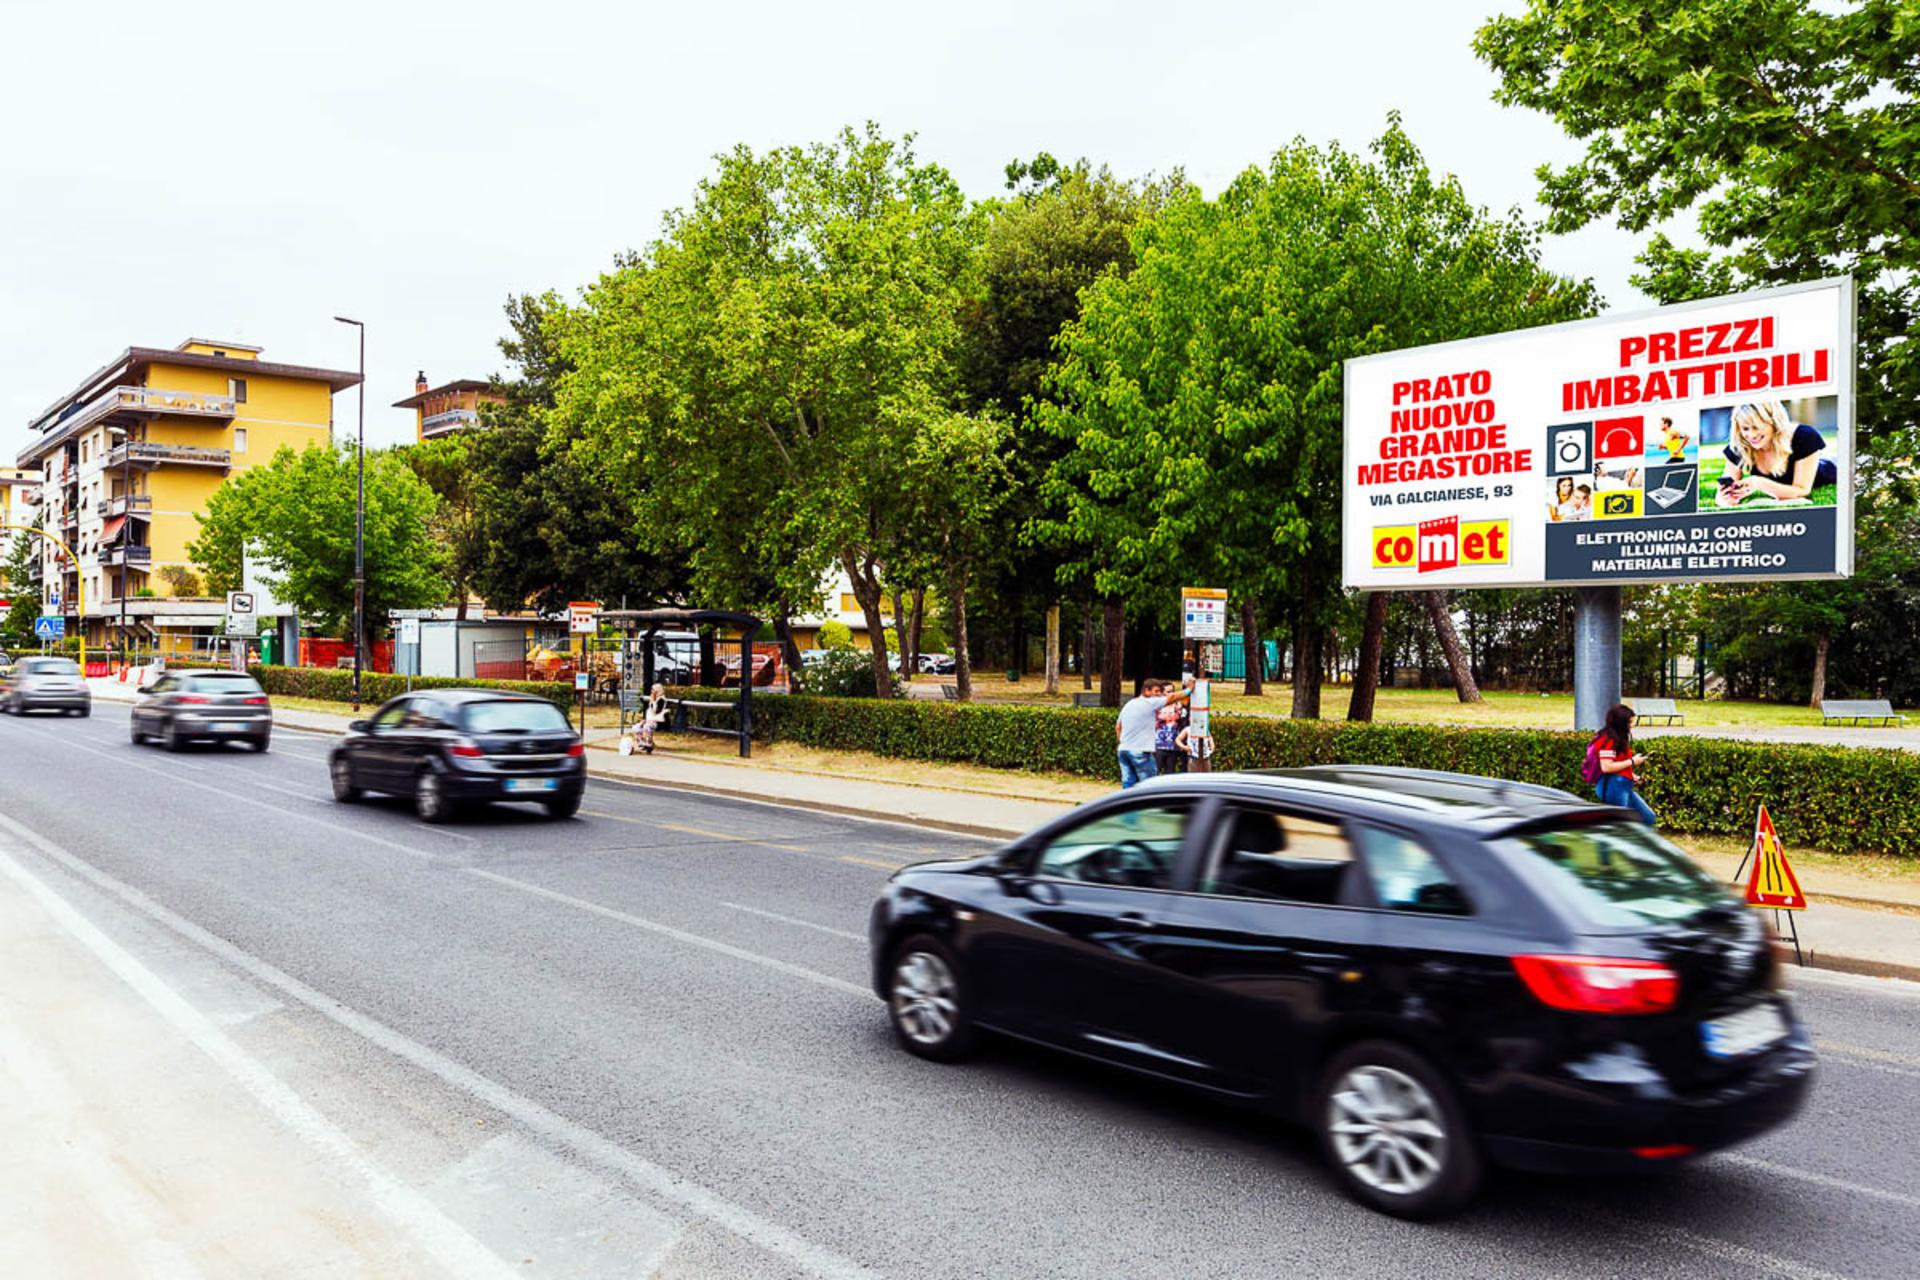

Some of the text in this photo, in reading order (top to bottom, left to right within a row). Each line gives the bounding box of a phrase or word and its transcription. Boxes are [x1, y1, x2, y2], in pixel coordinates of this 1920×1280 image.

[1620, 316, 1773, 368] PREZZI
[1393, 370, 1491, 406] PRATO
[1562, 349, 1828, 412] IMBATTIBILI
[1391, 399, 1495, 434] NUOVO
[1379, 424, 1506, 460] GRANDE
[1357, 449, 1532, 486] MEGASTORE
[1370, 485, 1513, 506] VIA GALCIANESE, 93
[1375, 525, 1504, 563] comet
[1576, 522, 1807, 545] ELETTRONICA DI CONSUMO
[1621, 540, 1752, 557] ILLUMINAZIONE
[1592, 553, 1786, 572] MATERIALE ELETTRICO
